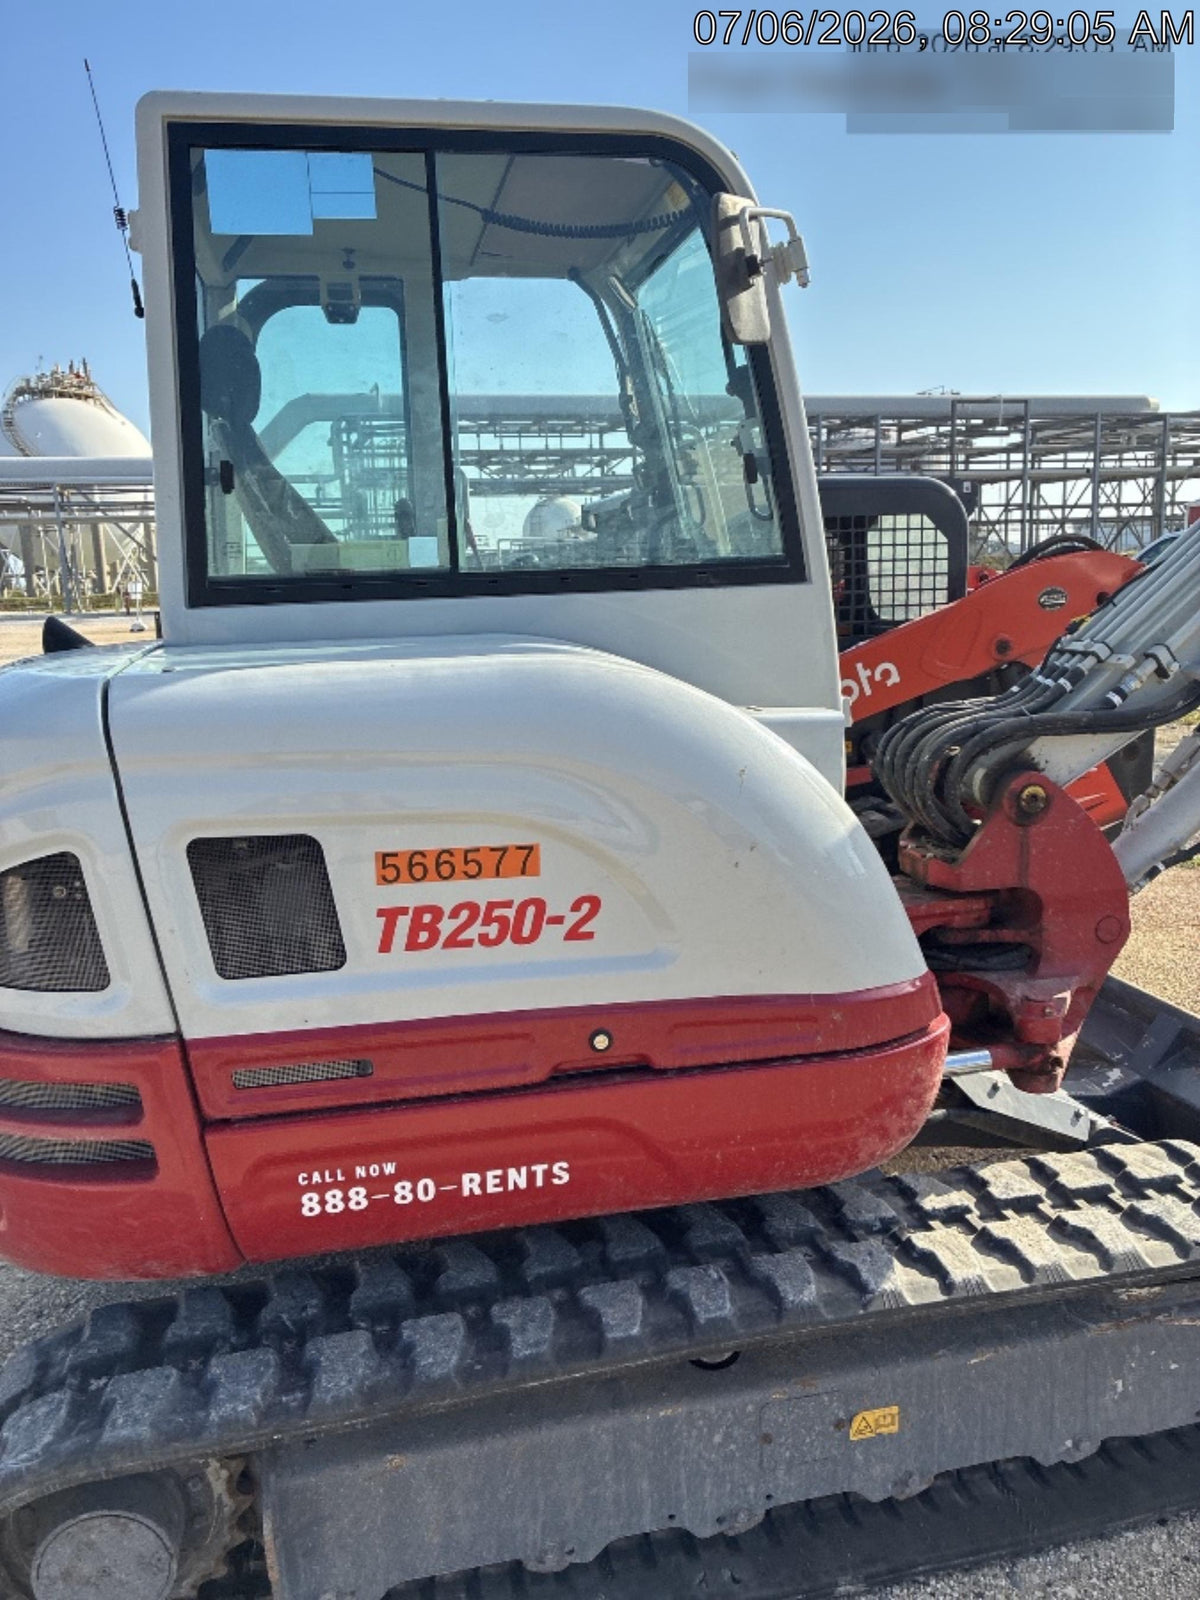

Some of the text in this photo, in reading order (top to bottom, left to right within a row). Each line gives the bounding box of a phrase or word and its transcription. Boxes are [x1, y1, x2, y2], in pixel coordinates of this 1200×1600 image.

[381, 846, 534, 884] 566577
[376, 894, 601, 953] TB250-2
[298, 1162, 397, 1186] CALL NOW
[300, 1161, 571, 1217] 888-80-RENTS
